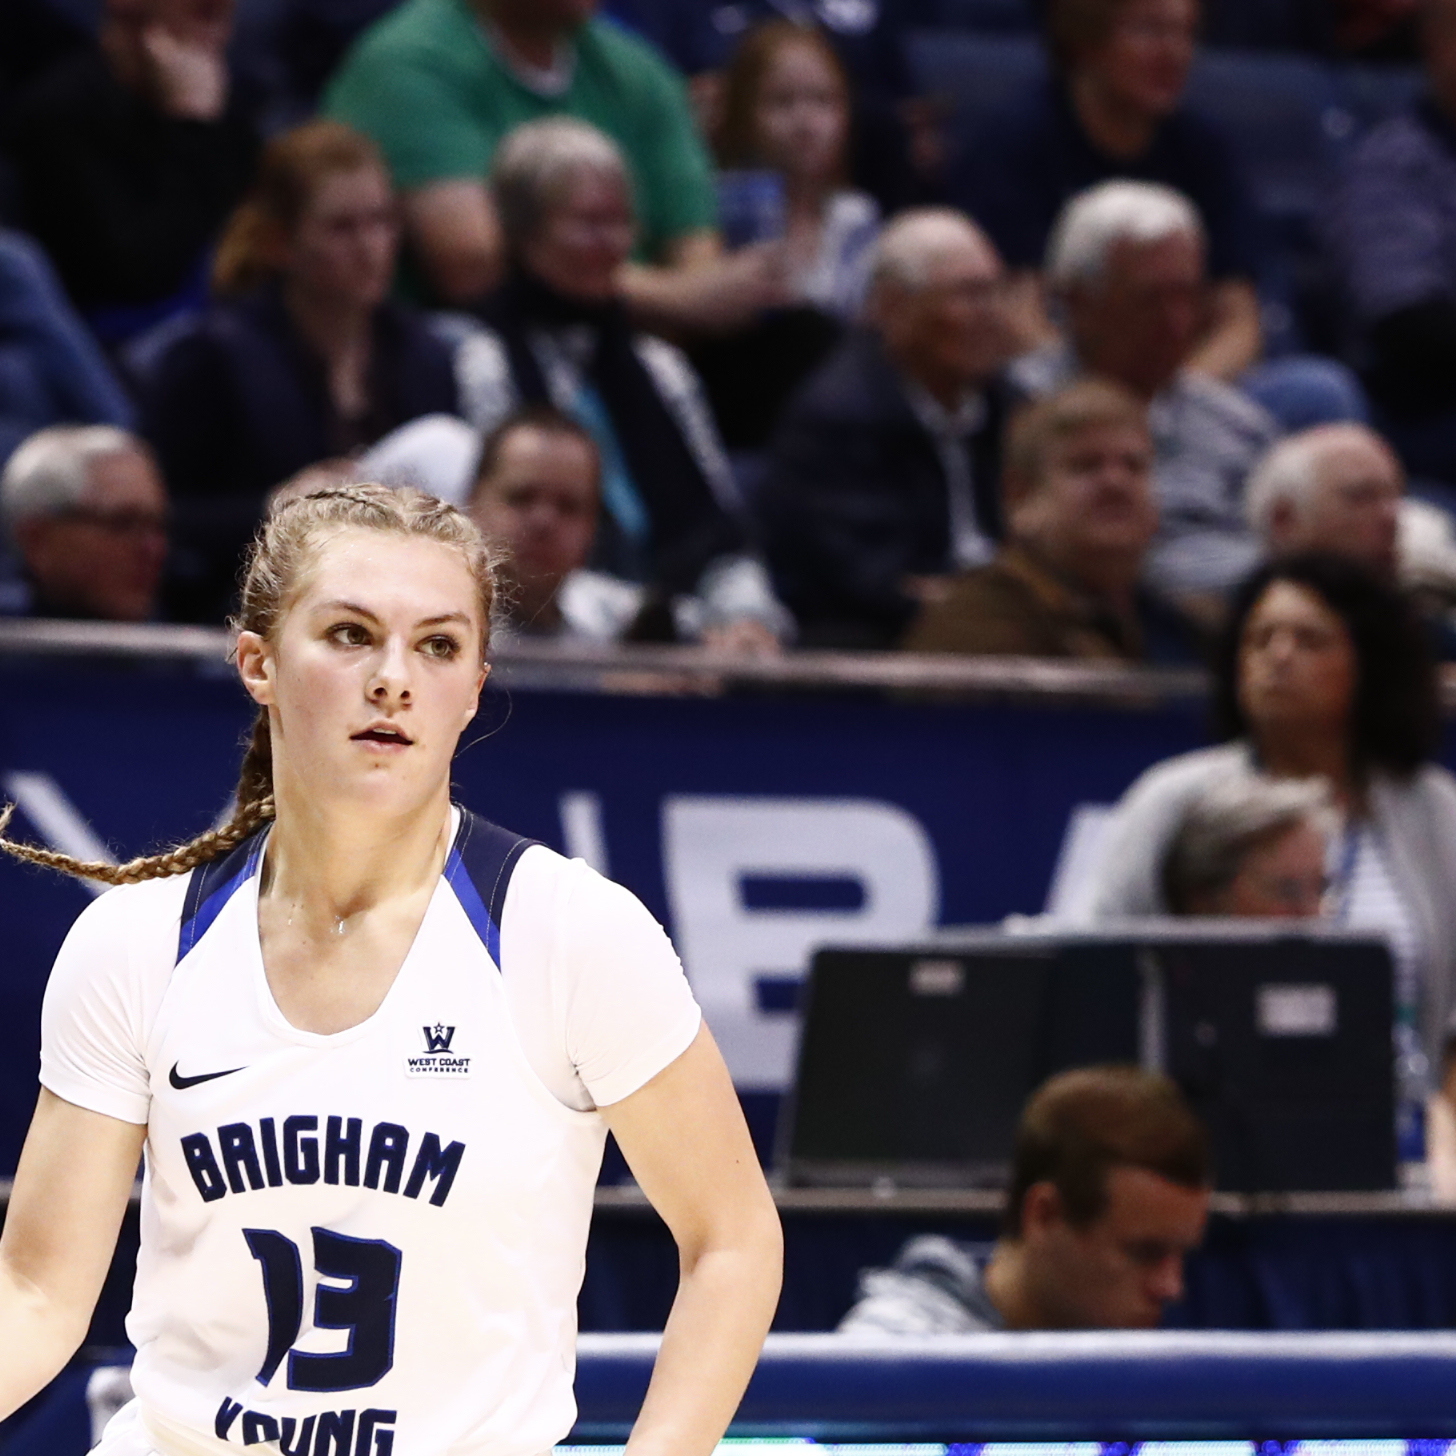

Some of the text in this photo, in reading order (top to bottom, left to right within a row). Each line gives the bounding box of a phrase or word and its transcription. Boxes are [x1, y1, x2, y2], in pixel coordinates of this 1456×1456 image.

[407, 1058, 471, 1067] WEST COAST
[180, 1115, 466, 1207] BRIGHAM
[241, 1225, 403, 1393] 13
